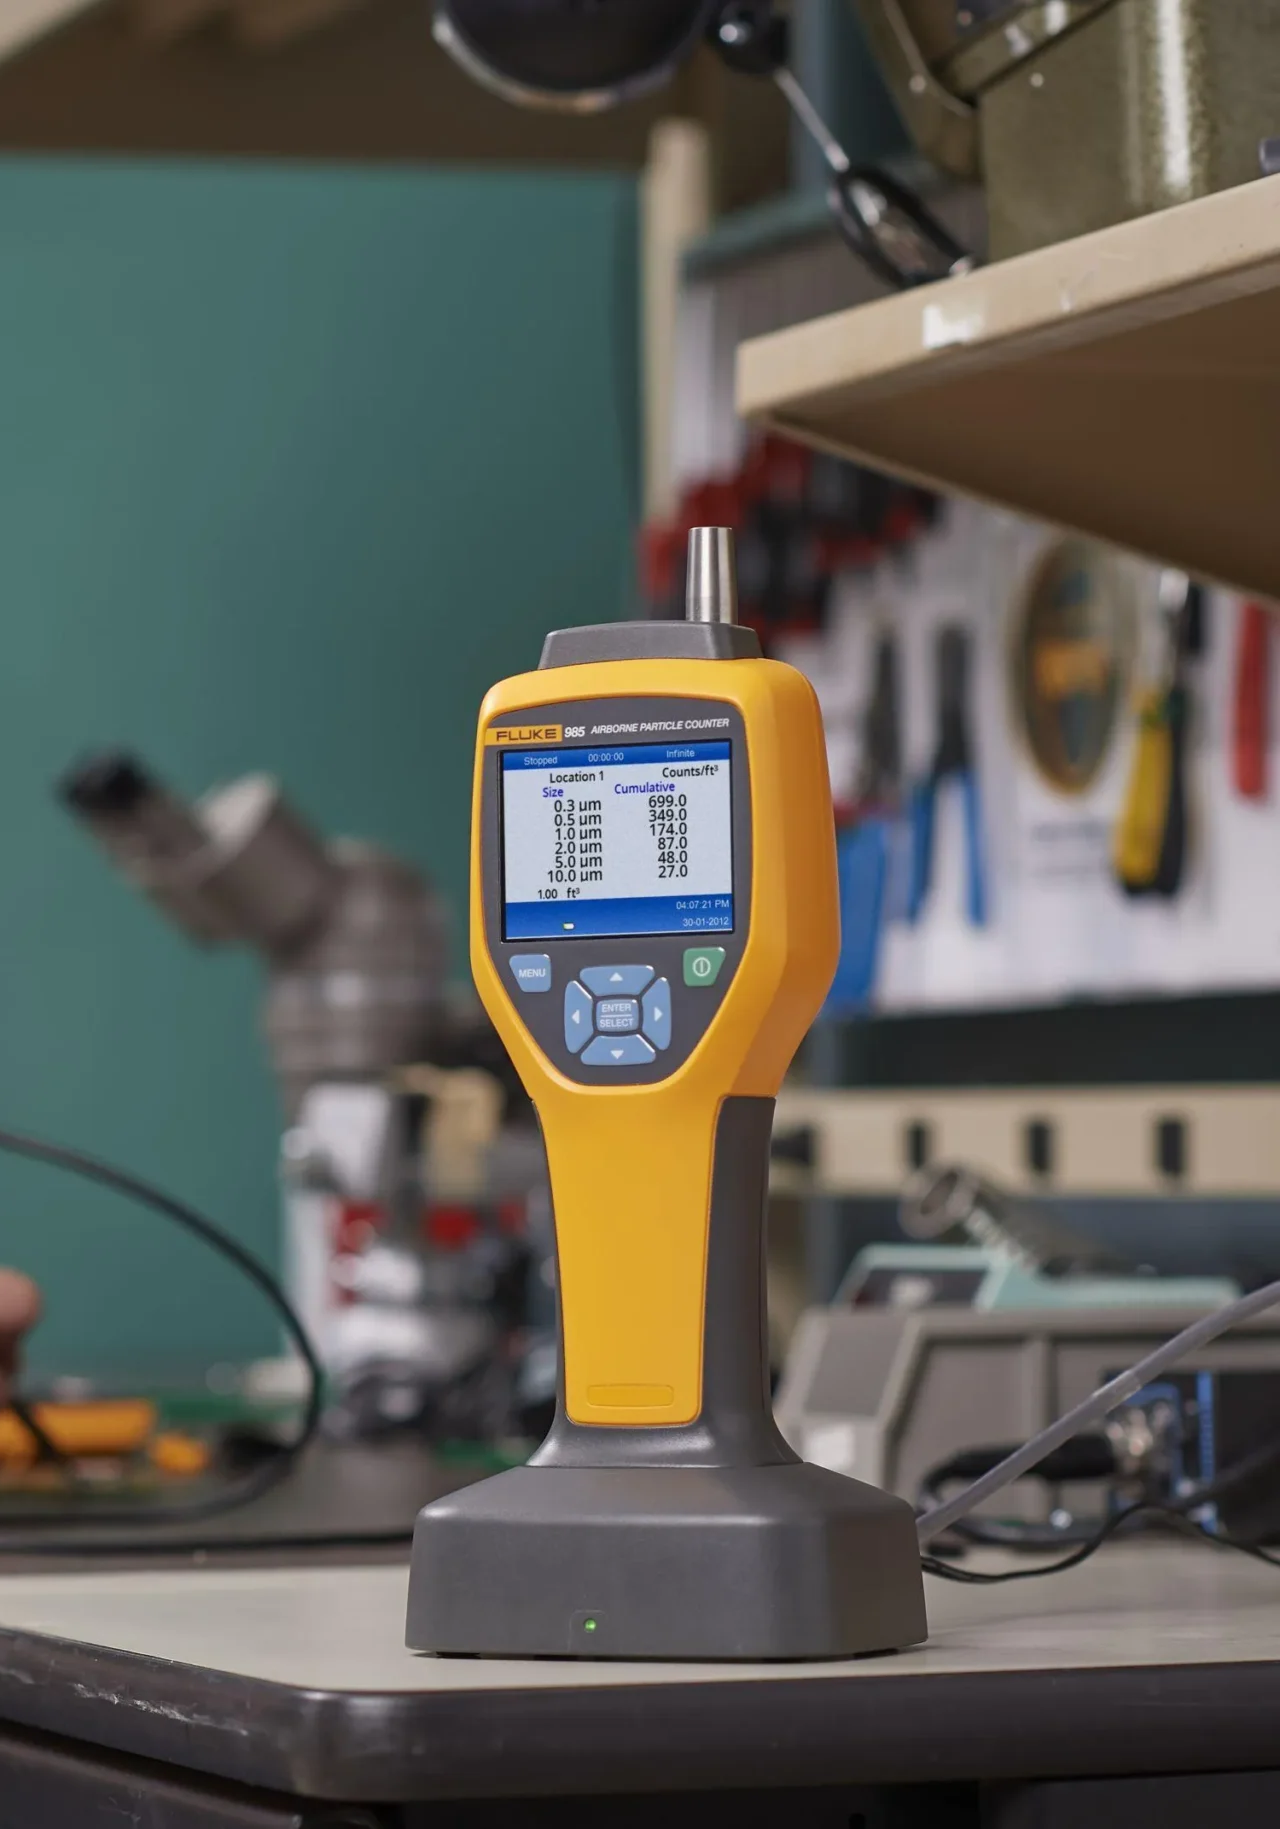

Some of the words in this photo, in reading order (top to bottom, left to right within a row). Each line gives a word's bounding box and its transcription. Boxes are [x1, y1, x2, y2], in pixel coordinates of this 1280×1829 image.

[496, 728, 557, 741] FLUKE
[564, 726, 586, 738] 985
[590, 723, 639, 734] AIRBORNE
[639, 720, 684, 731] PARTICLE
[685, 718, 730, 729] COUNTER
[588, 752, 624, 762] 00:00:00
[666, 749, 695, 758] Infinite
[523, 756, 558, 767] Stopped
[549, 771, 596, 783] Location
[599, 771, 604, 781] 1
[542, 787, 564, 798] Size
[614, 781, 676, 794] Cumulative
[554, 800, 575, 812] 0.3
[648, 794, 687, 809] 699.0
[554, 814, 575, 826] 0.5
[648, 808, 687, 822] 349.0
[555, 828, 576, 840] 1.0
[650, 822, 687, 837] 174.0
[555, 841, 576, 854] 2.0
[657, 837, 688, 850] 87.0
[555, 856, 576, 868] 5.0
[657, 851, 688, 865] 48.0
[547, 869, 576, 883] 10.0
[658, 865, 688, 879] 27.0
[537, 888, 558, 899] 1.00
[676, 900, 712, 910] 04:07:21
[714, 899, 729, 909] PM
[682, 917, 729, 927] 30-01-2012
[518, 968, 546, 979] MENU
[601, 1003, 632, 1013] ENTER
[599, 1018, 634, 1028] SELECT
